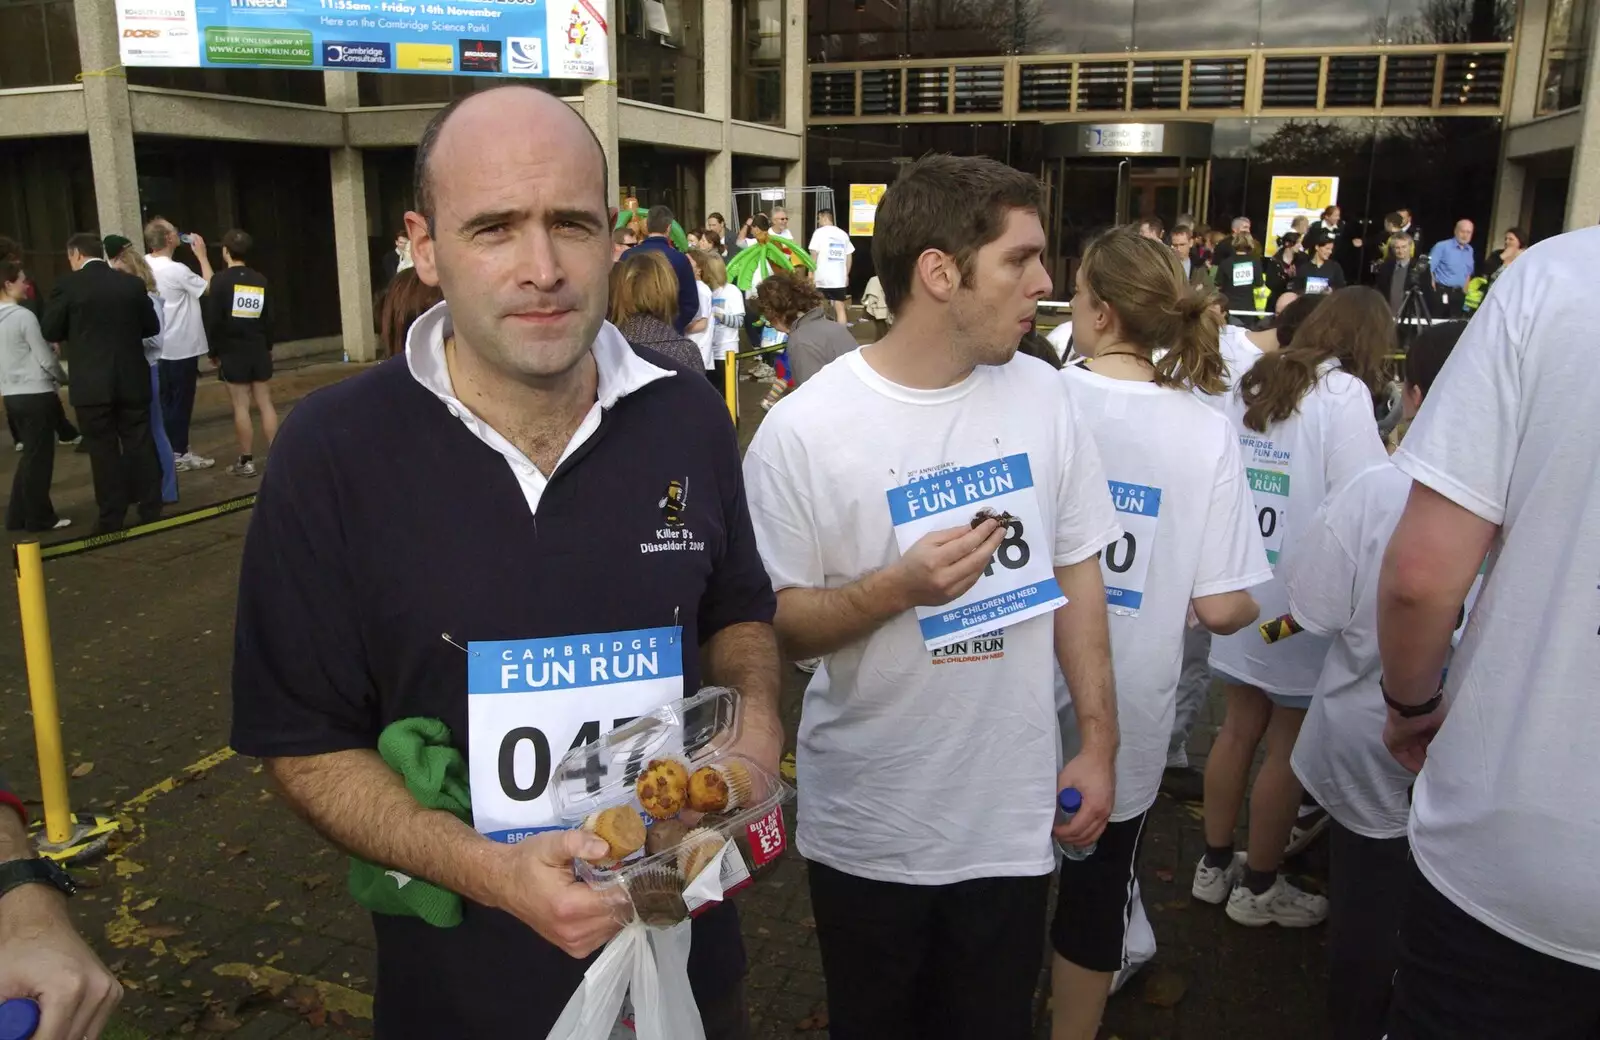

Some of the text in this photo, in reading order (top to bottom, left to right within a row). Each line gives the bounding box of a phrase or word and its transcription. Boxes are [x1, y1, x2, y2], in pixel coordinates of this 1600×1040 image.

[321, 0, 370, 11] 11:55am
[382, 2, 416, 16] Friday
[420, 5, 444, 15] 14th
[447, 6, 502, 18] November
[320, 16, 343, 26] Here
[346, 19, 358, 27] on
[361, 17, 375, 27] the
[378, 18, 429, 32] Cambridge
[431, 21, 466, 32] Science
[123, 29, 161, 38] DCRS
[242, 37, 272, 45] ONLINE
[209, 46, 310, 56] WWW.CAMFUNRUN.ORG
[342, 46, 383, 56] Cambridge
[342, 55, 386, 63] Consultants
[237, 297, 260, 309] 088
[1254, 448, 1290, 460] FUN RUN
[906, 463, 1009, 498] CAMBRIDGE
[1254, 479, 1281, 493] RUN
[908, 488, 957, 518] FUN
[964, 473, 1014, 501] RUN
[1115, 496, 1144, 513] UN
[656, 528, 693, 539] Killer B's
[640, 541, 705, 554] Düsseldorf 2008
[943, 586, 1038, 623] BBC CHILDREN IN NEED
[961, 600, 1027, 627] Raise a Smile!
[502, 637, 657, 661] CAMBRIDGE
[973, 638, 1004, 652] RUN
[947, 656, 981, 664] CHILDREN
[990, 651, 1004, 660] NEED
[501, 651, 658, 689] FUN RUN
[750, 818, 766, 832] BUY
[758, 819, 778, 838] 2 FOR
[760, 827, 782, 854] £3
